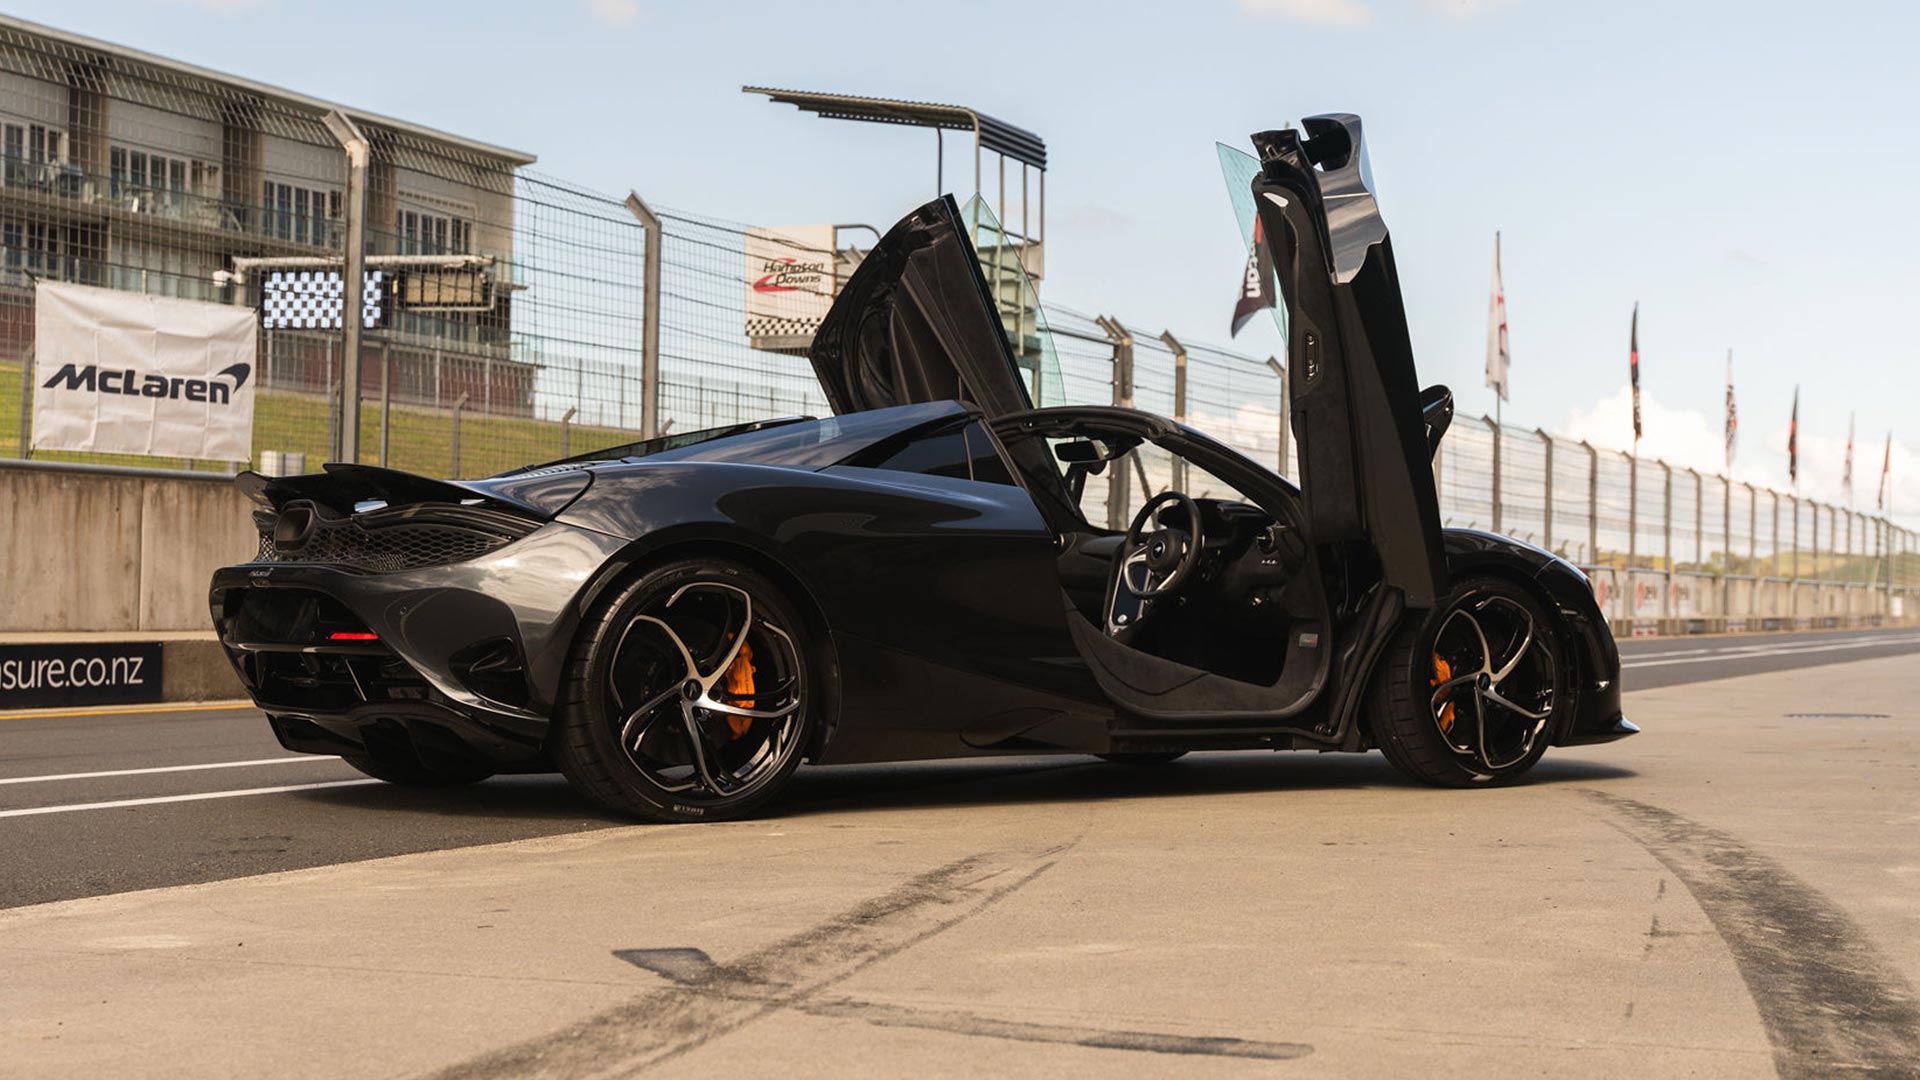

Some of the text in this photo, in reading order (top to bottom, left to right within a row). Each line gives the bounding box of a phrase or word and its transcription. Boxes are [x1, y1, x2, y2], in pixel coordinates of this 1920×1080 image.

[763, 262, 824, 274] Hampton
[775, 272, 821, 285] Downs
[42, 363, 230, 405] McLaren
[0, 657, 144, 690] sure.co.nz
